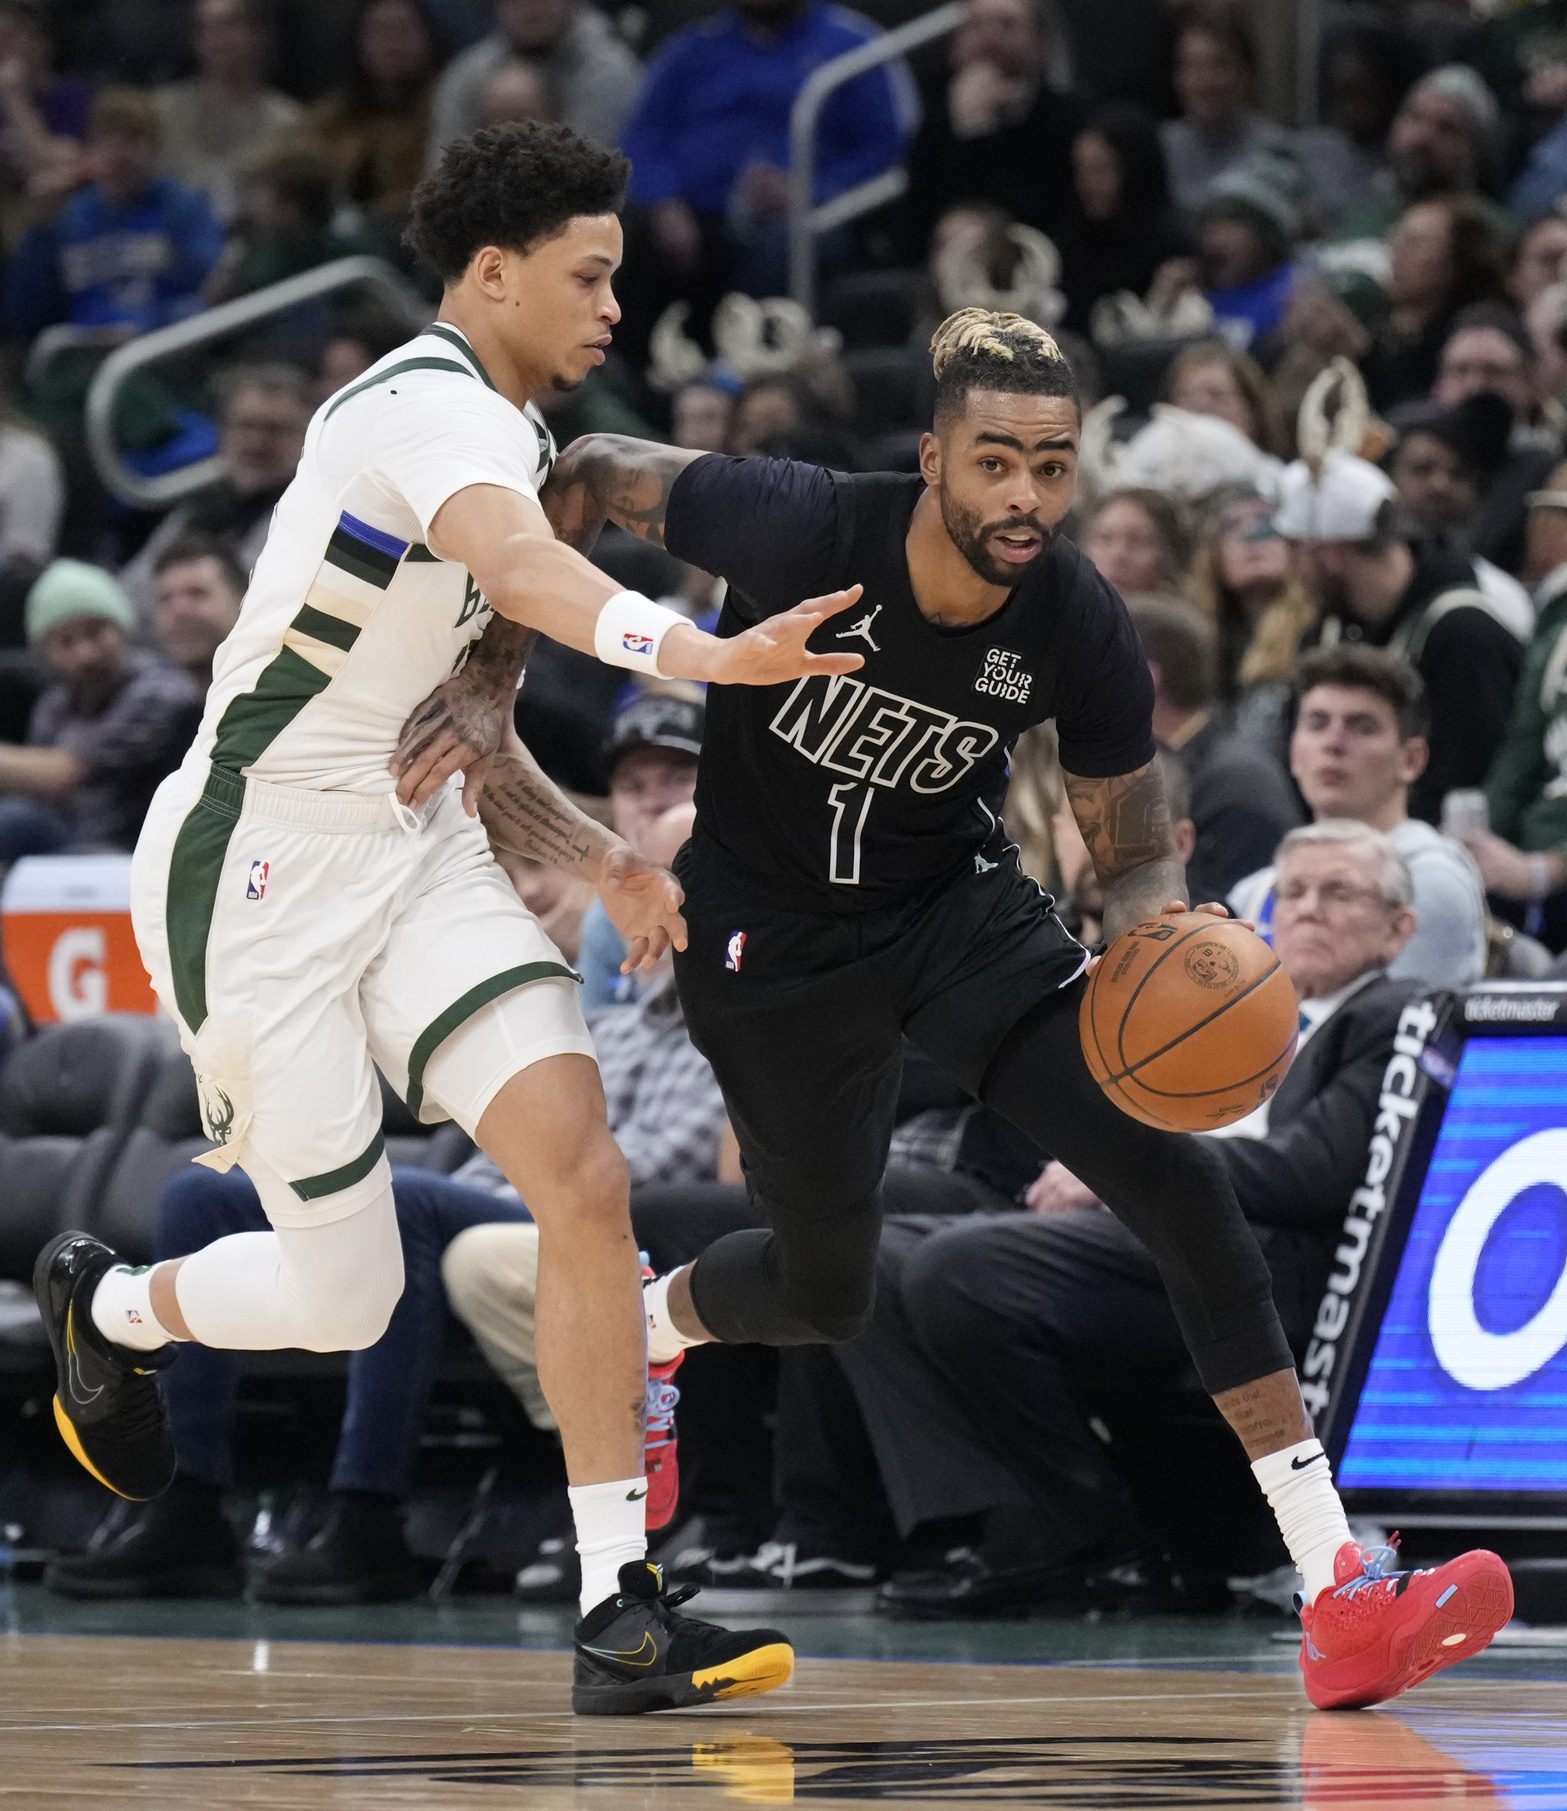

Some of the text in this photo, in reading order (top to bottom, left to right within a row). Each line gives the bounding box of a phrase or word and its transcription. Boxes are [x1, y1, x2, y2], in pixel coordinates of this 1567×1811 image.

[984, 662, 1033, 690] YOUR
[986, 648, 1022, 669] GET
[975, 677, 1031, 704] GUIDE
[769, 674, 999, 794] NETS
[827, 781, 875, 885] 1
[47, 926, 108, 1023] G
[1463, 995, 1560, 1021] ticketmaster
[1300, 1000, 1438, 1420] ticketmast
